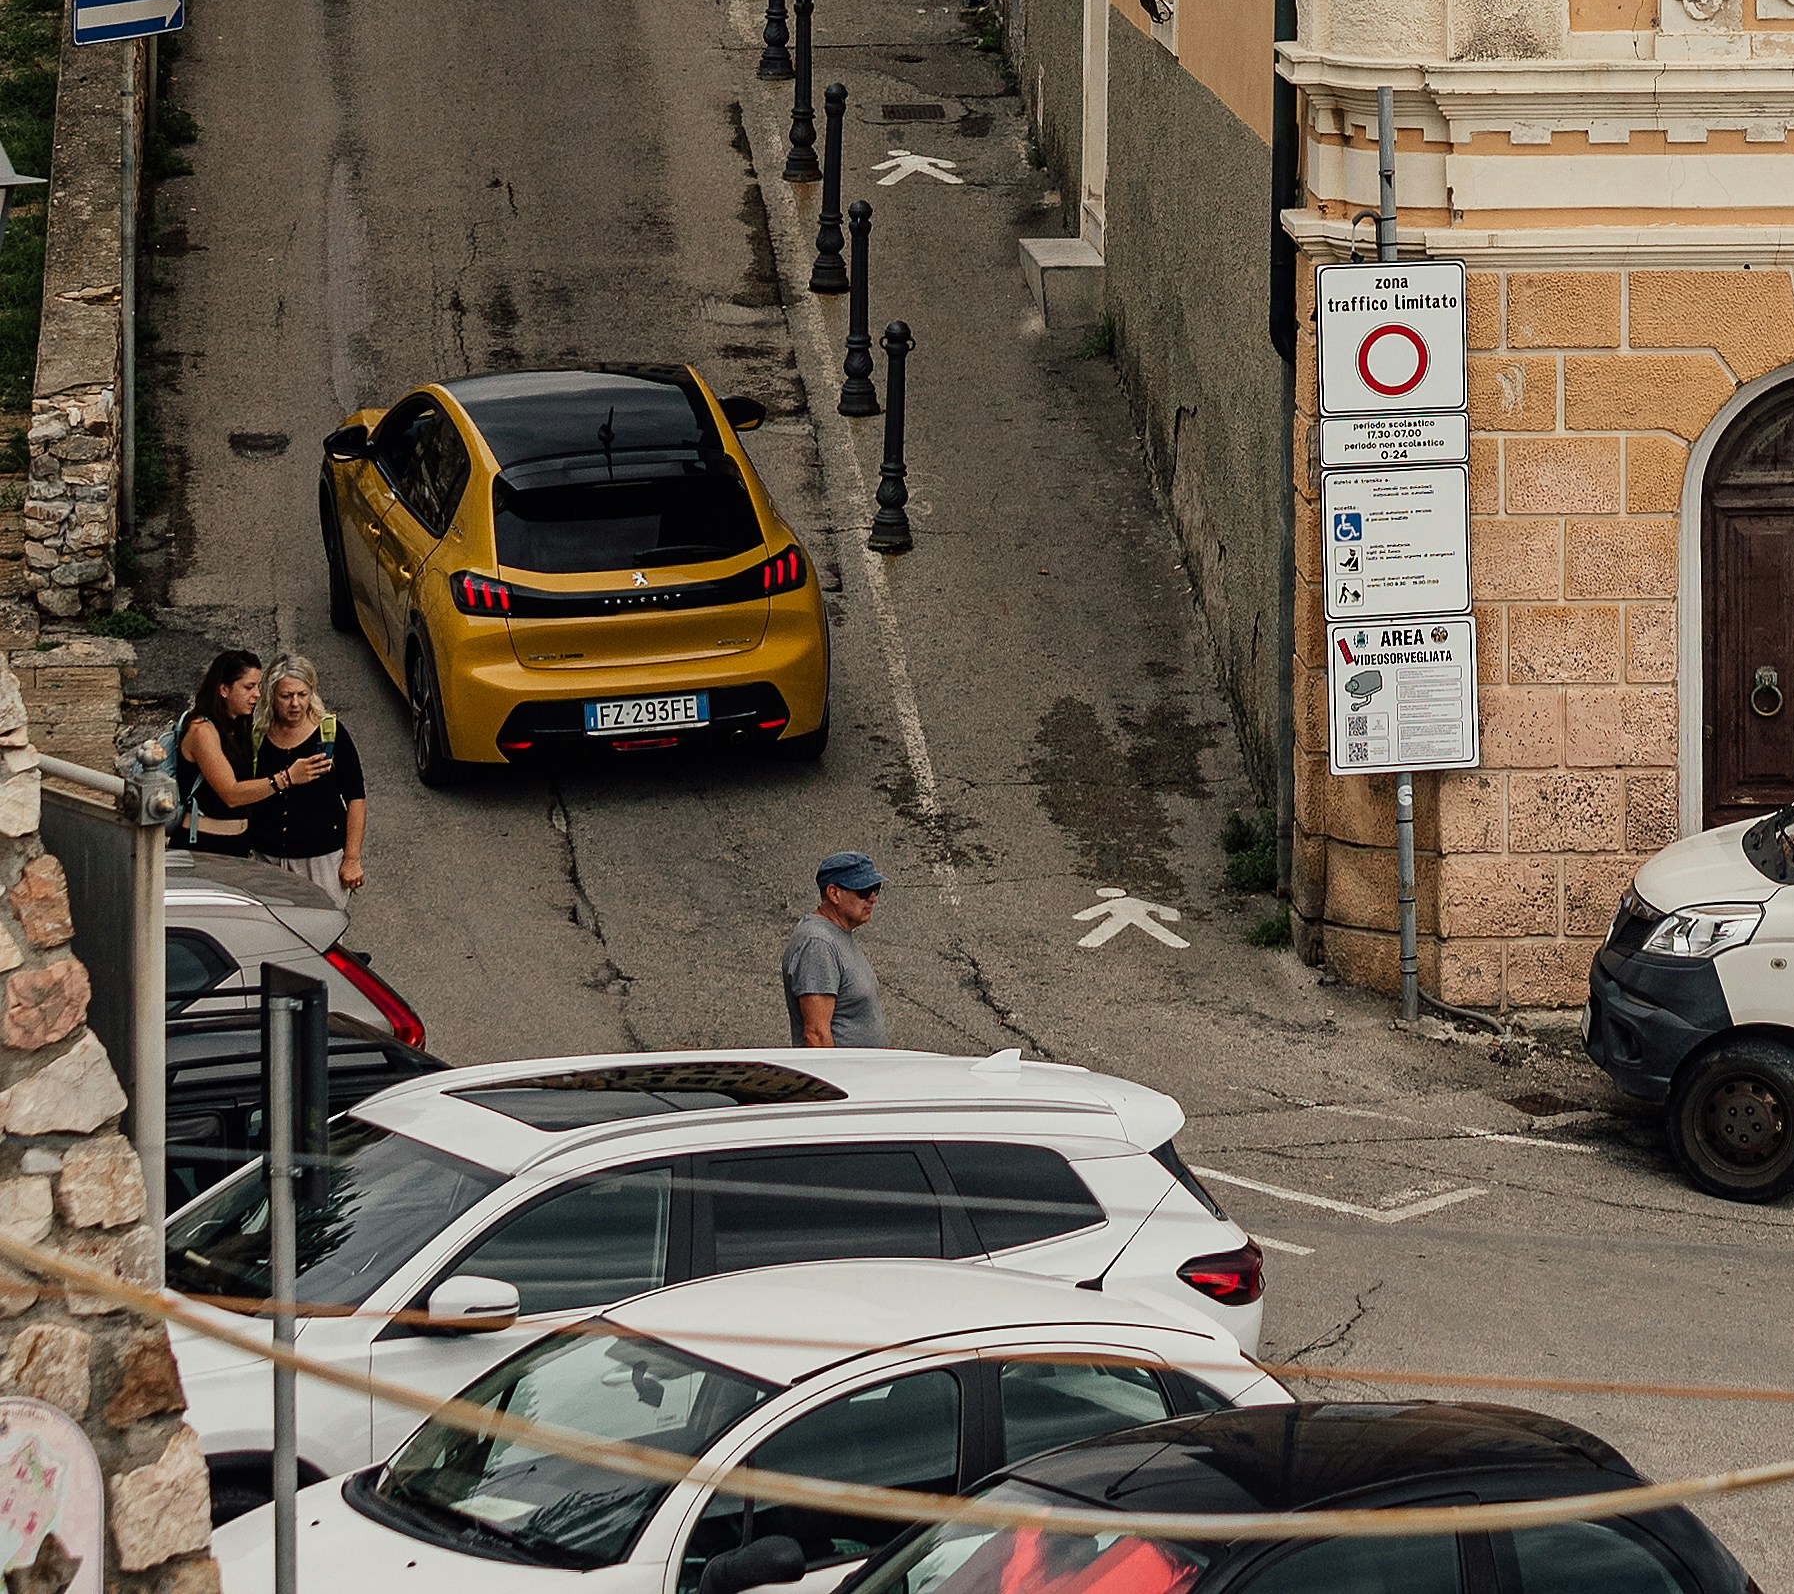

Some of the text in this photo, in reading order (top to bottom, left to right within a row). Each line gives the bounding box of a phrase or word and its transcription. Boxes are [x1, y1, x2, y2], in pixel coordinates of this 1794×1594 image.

[1375, 277, 1408, 290] zona
[1328, 294, 1457, 313] traffico limitato
[1353, 419, 1435, 431] periodo scolastico
[1344, 442, 1377, 452] periodo
[1398, 439, 1445, 448] scolastico
[1380, 449, 1408, 460] 0-24
[1380, 629, 1424, 647] AREA
[1353, 650, 1453, 666] VIDEOSORVEGLIATA
